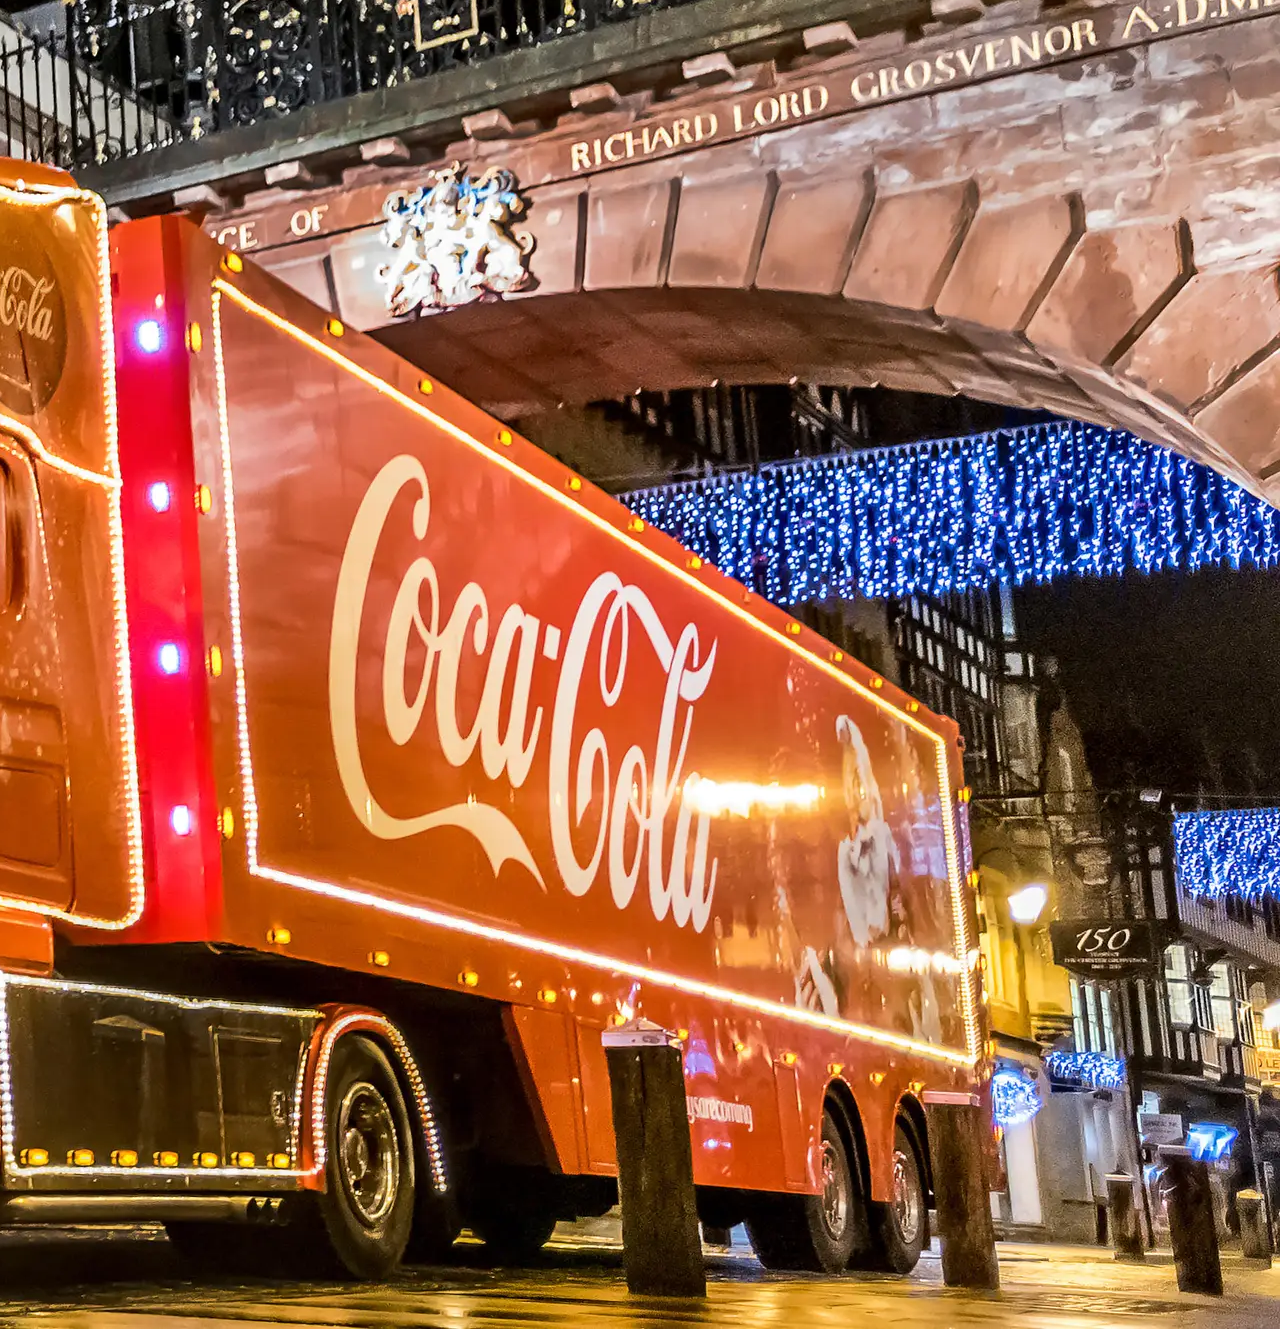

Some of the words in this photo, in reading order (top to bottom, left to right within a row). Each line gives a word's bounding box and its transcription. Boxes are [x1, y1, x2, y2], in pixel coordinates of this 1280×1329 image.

[210, 221, 258, 251] CE
[290, 203, 329, 236] OF
[570, 112, 719, 172] RICHARD
[732, 83, 830, 133] LORD
[850, 17, 1098, 104] GROSVENOR
[329, 454, 719, 935] Coca-Cola
[1075, 926, 1131, 952] 150
[686, 1094, 753, 1132] ysarecoming
